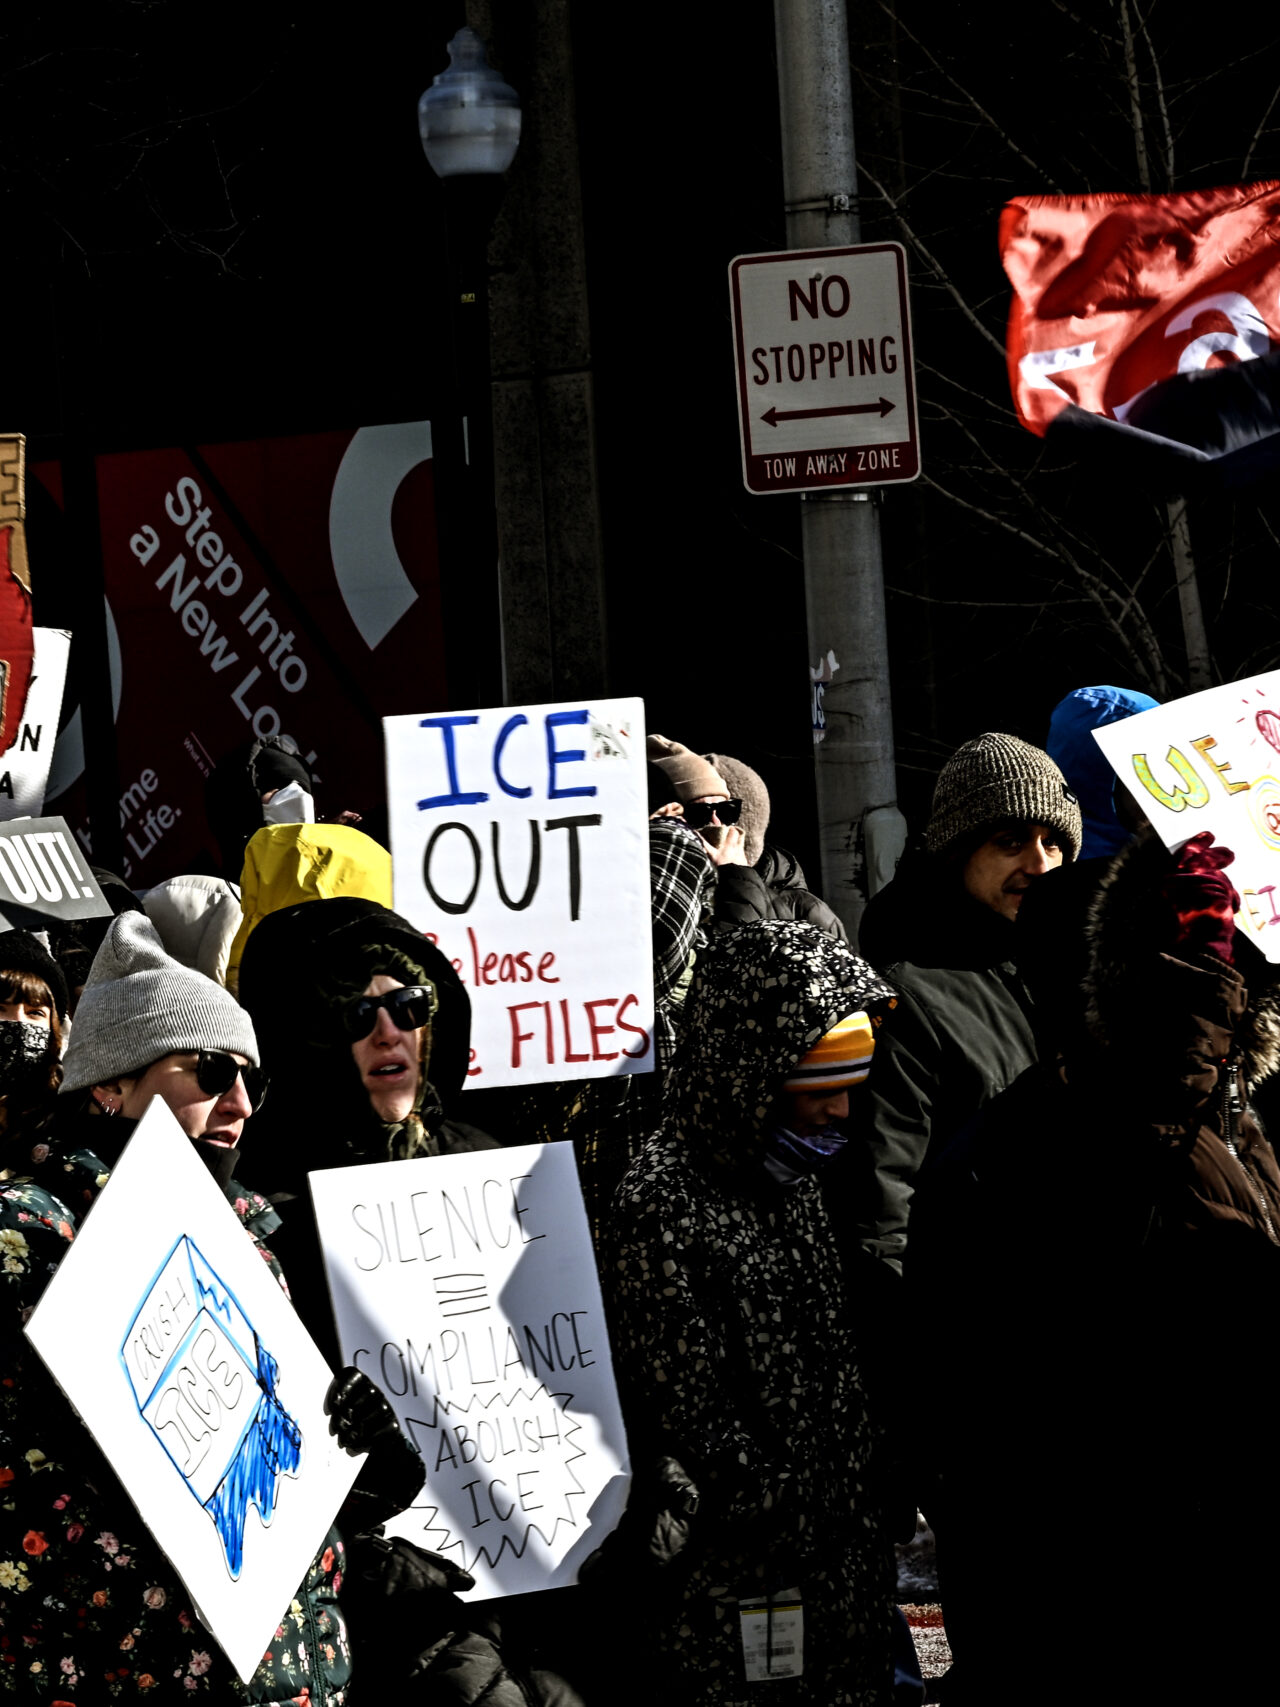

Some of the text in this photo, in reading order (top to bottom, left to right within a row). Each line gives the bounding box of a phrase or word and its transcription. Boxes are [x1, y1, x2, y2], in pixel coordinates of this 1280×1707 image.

[788, 275, 850, 321] NO
[751, 336, 897, 386] STOPPING
[764, 448, 901, 479] TOW AWAY ZONE
[128, 523, 161, 567] a
[154, 552, 240, 675] New
[164, 475, 309, 693] Step Into
[417, 709, 597, 811] ICE
[1132, 734, 1250, 812] WE
[126, 803, 182, 861] Life.
[423, 814, 602, 922] OUT
[506, 993, 650, 1069] FILES
[352, 1175, 547, 1272] SILENCE
[133, 1277, 191, 1382] CRUSH
[154, 1328, 243, 1478] ICE
[435, 1408, 561, 1472] ABOLISH
[461, 1470, 544, 1528] ICE
